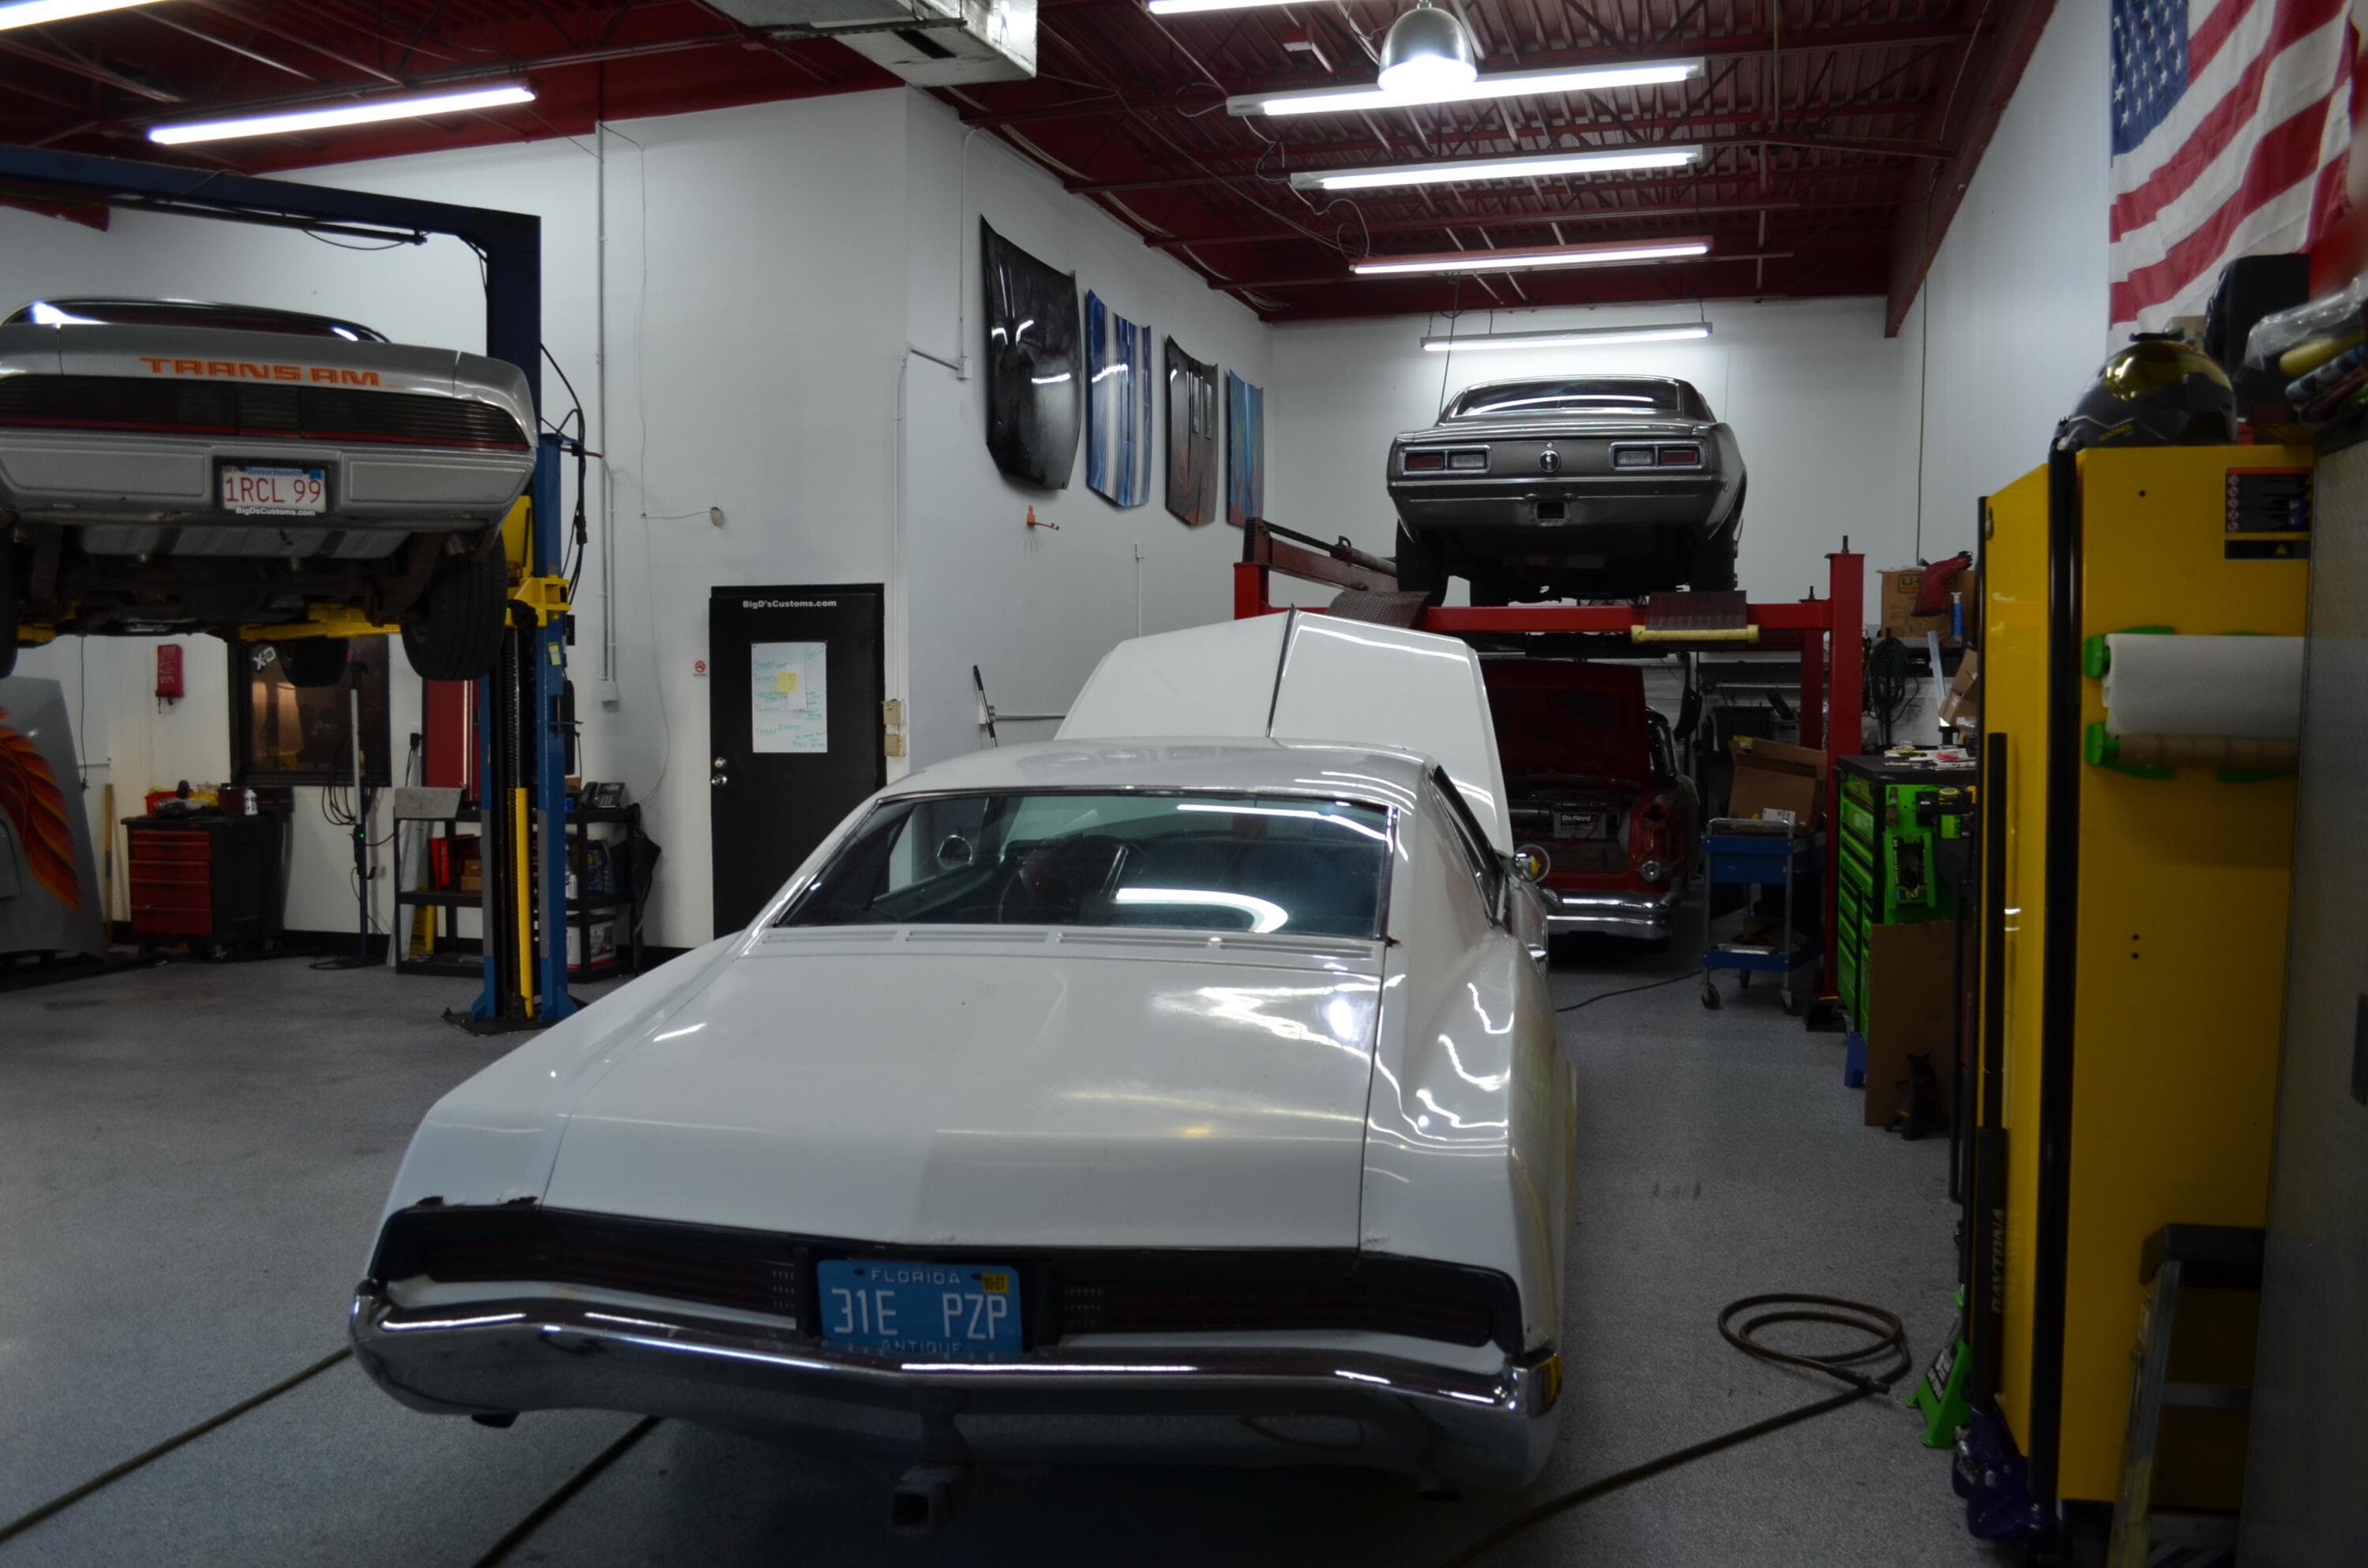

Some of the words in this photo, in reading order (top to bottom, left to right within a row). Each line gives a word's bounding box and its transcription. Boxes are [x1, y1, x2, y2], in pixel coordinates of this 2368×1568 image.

[140, 357, 302, 381] TRANS
[311, 367, 380, 387] AM
[226, 477, 285, 503] 1RCL
[294, 479, 321, 503] 99
[235, 507, 316, 517] BigDsCustoms.com
[742, 600, 837, 609] BigD'sCustoms.com
[1991, 1207, 2004, 1315] DAYTONA
[871, 1269, 961, 1285] FLORIDA
[831, 1287, 898, 1336] 31E
[942, 1293, 1009, 1341] PZP
